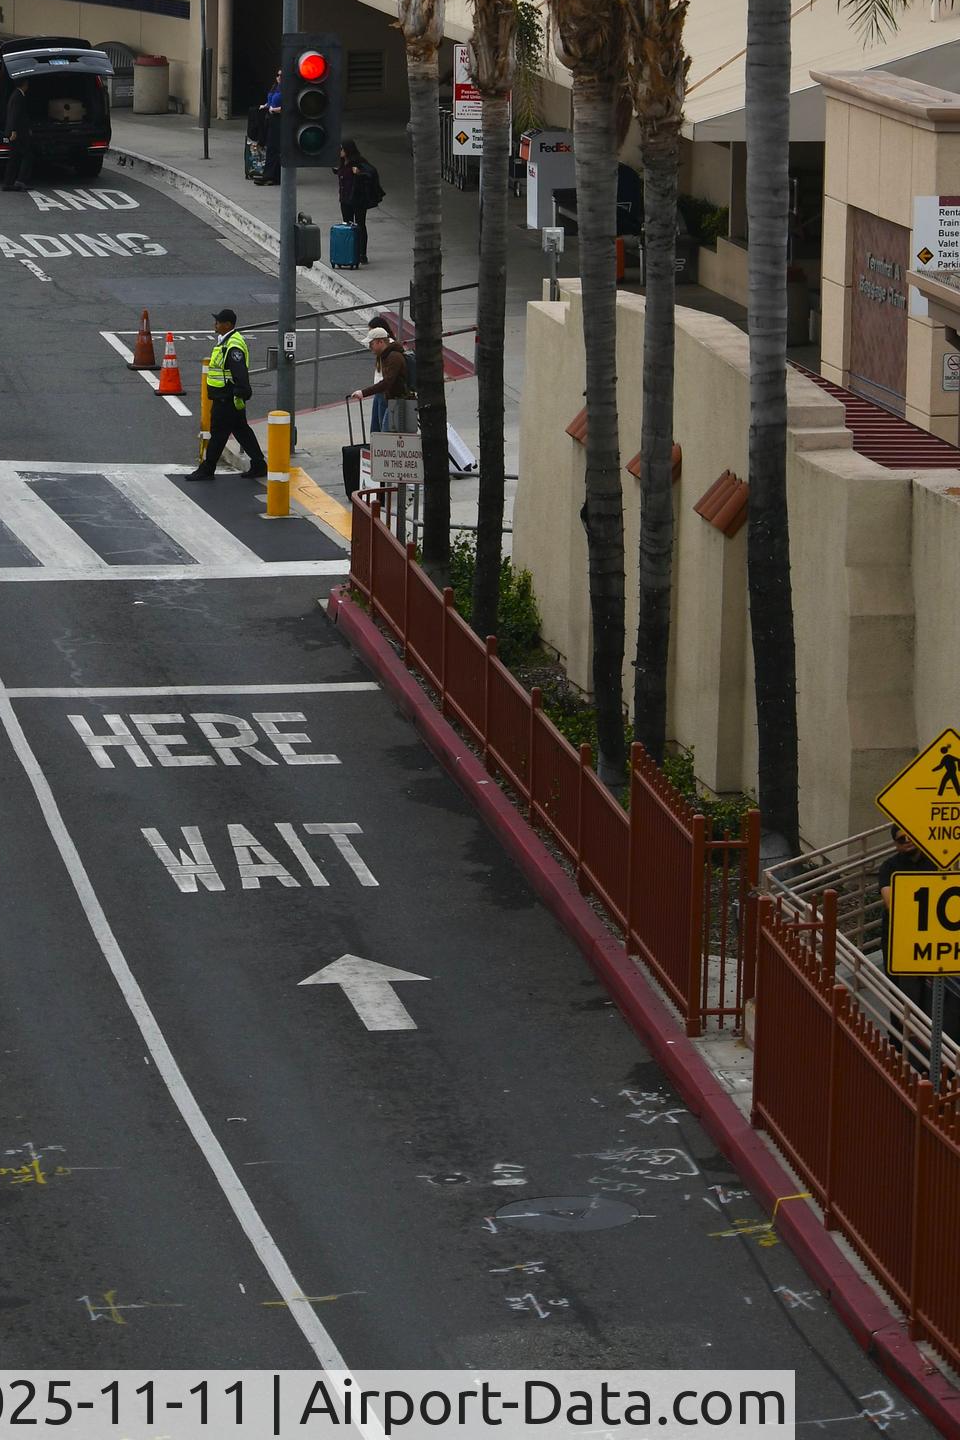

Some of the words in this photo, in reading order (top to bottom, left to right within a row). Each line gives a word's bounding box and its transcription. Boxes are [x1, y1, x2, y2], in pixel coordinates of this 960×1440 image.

[540, 142, 572, 153] FedEx
[26, 188, 141, 212] AND
[937, 239, 959, 247] Valet
[937, 250, 960, 258] Taxis
[866, 252, 893, 279] Terminal
[893, 262, 902, 281] A
[937, 260, 960, 268] Parki
[859, 273, 887, 304] Baggage
[888, 286, 906, 310] Claim
[396, 440, 405, 448] NO
[391, 460, 403, 468] THIS
[404, 460, 418, 469] AREA
[66, 711, 343, 769] HERE
[930, 806, 960, 821] PED
[928, 826, 960, 841] XING
[140, 822, 380, 893] WAIT
